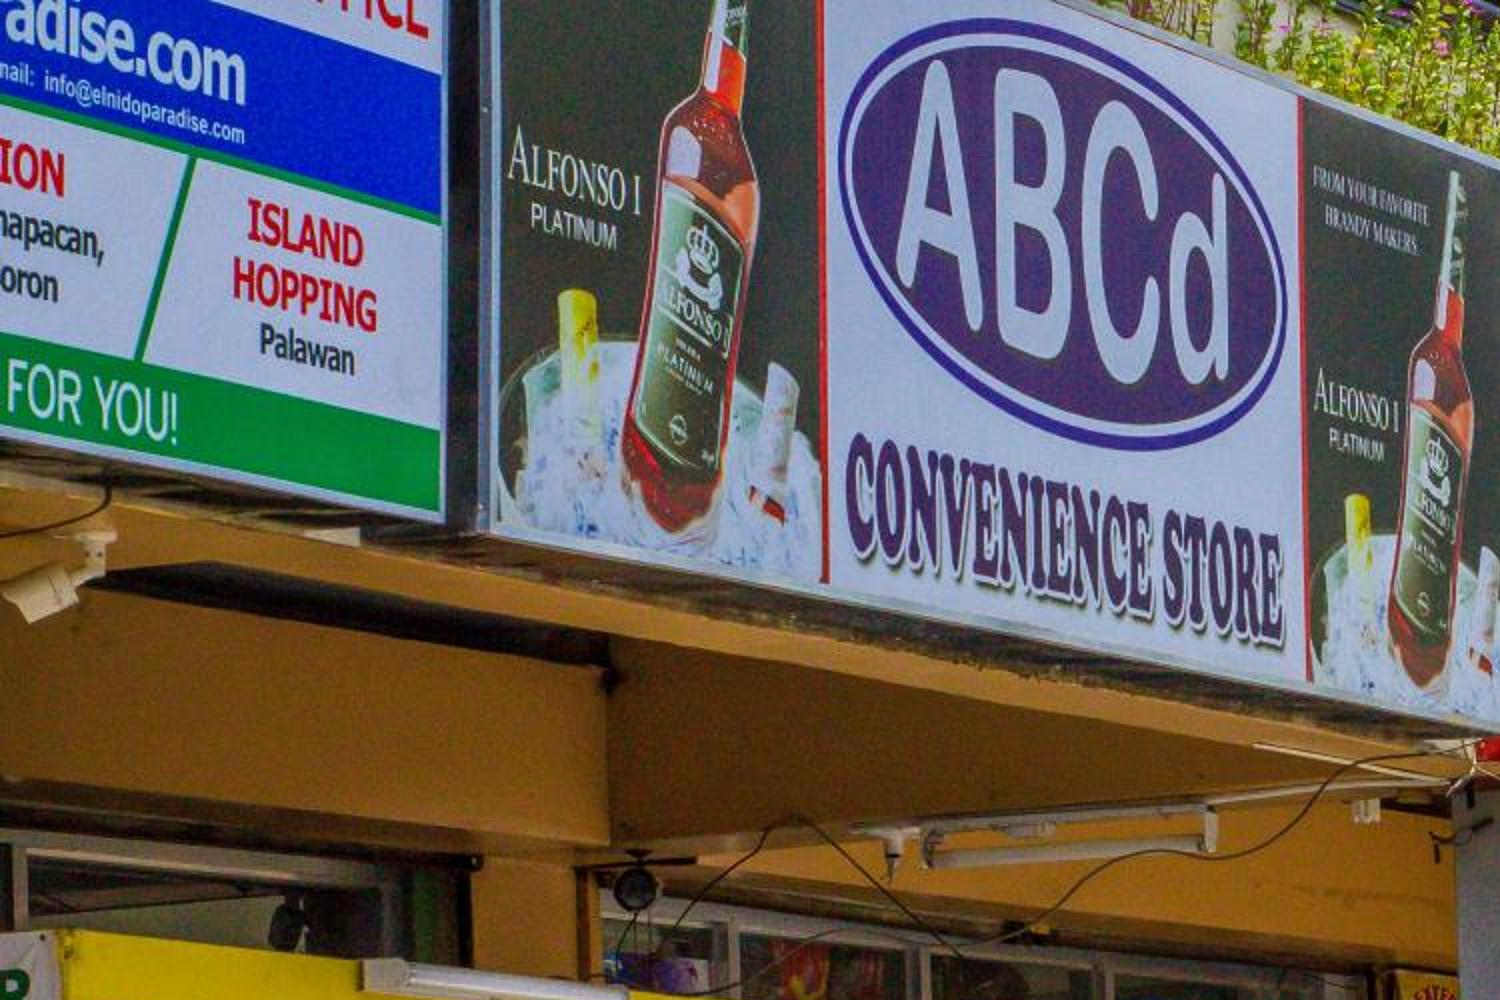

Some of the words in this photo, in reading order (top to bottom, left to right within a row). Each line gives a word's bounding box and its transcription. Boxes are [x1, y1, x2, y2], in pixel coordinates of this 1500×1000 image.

[44, 69, 246, 145] info@elnidoparadise.com
[507, 122, 627, 211] ALFONSO
[632, 174, 642, 216] I
[1312, 163, 1345, 196] FROM
[1346, 177, 1378, 206] YOUR
[247, 197, 365, 269] ISLAND
[531, 203, 618, 251] PLATINUM
[895, 60, 1230, 386] ABCd
[1324, 204, 1370, 240] BRANDY
[0, 264, 59, 303] oron
[232, 256, 378, 334] HOPPING
[260, 323, 355, 377] Palawan
[7, 357, 83, 427] FOR
[93, 374, 178, 448] YOU!
[1313, 367, 1389, 432] ALFONSO
[1329, 428, 1385, 462] PLATINUM
[845, 432, 1155, 613] CONVENIENCE
[1161, 510, 1286, 647] STORE
